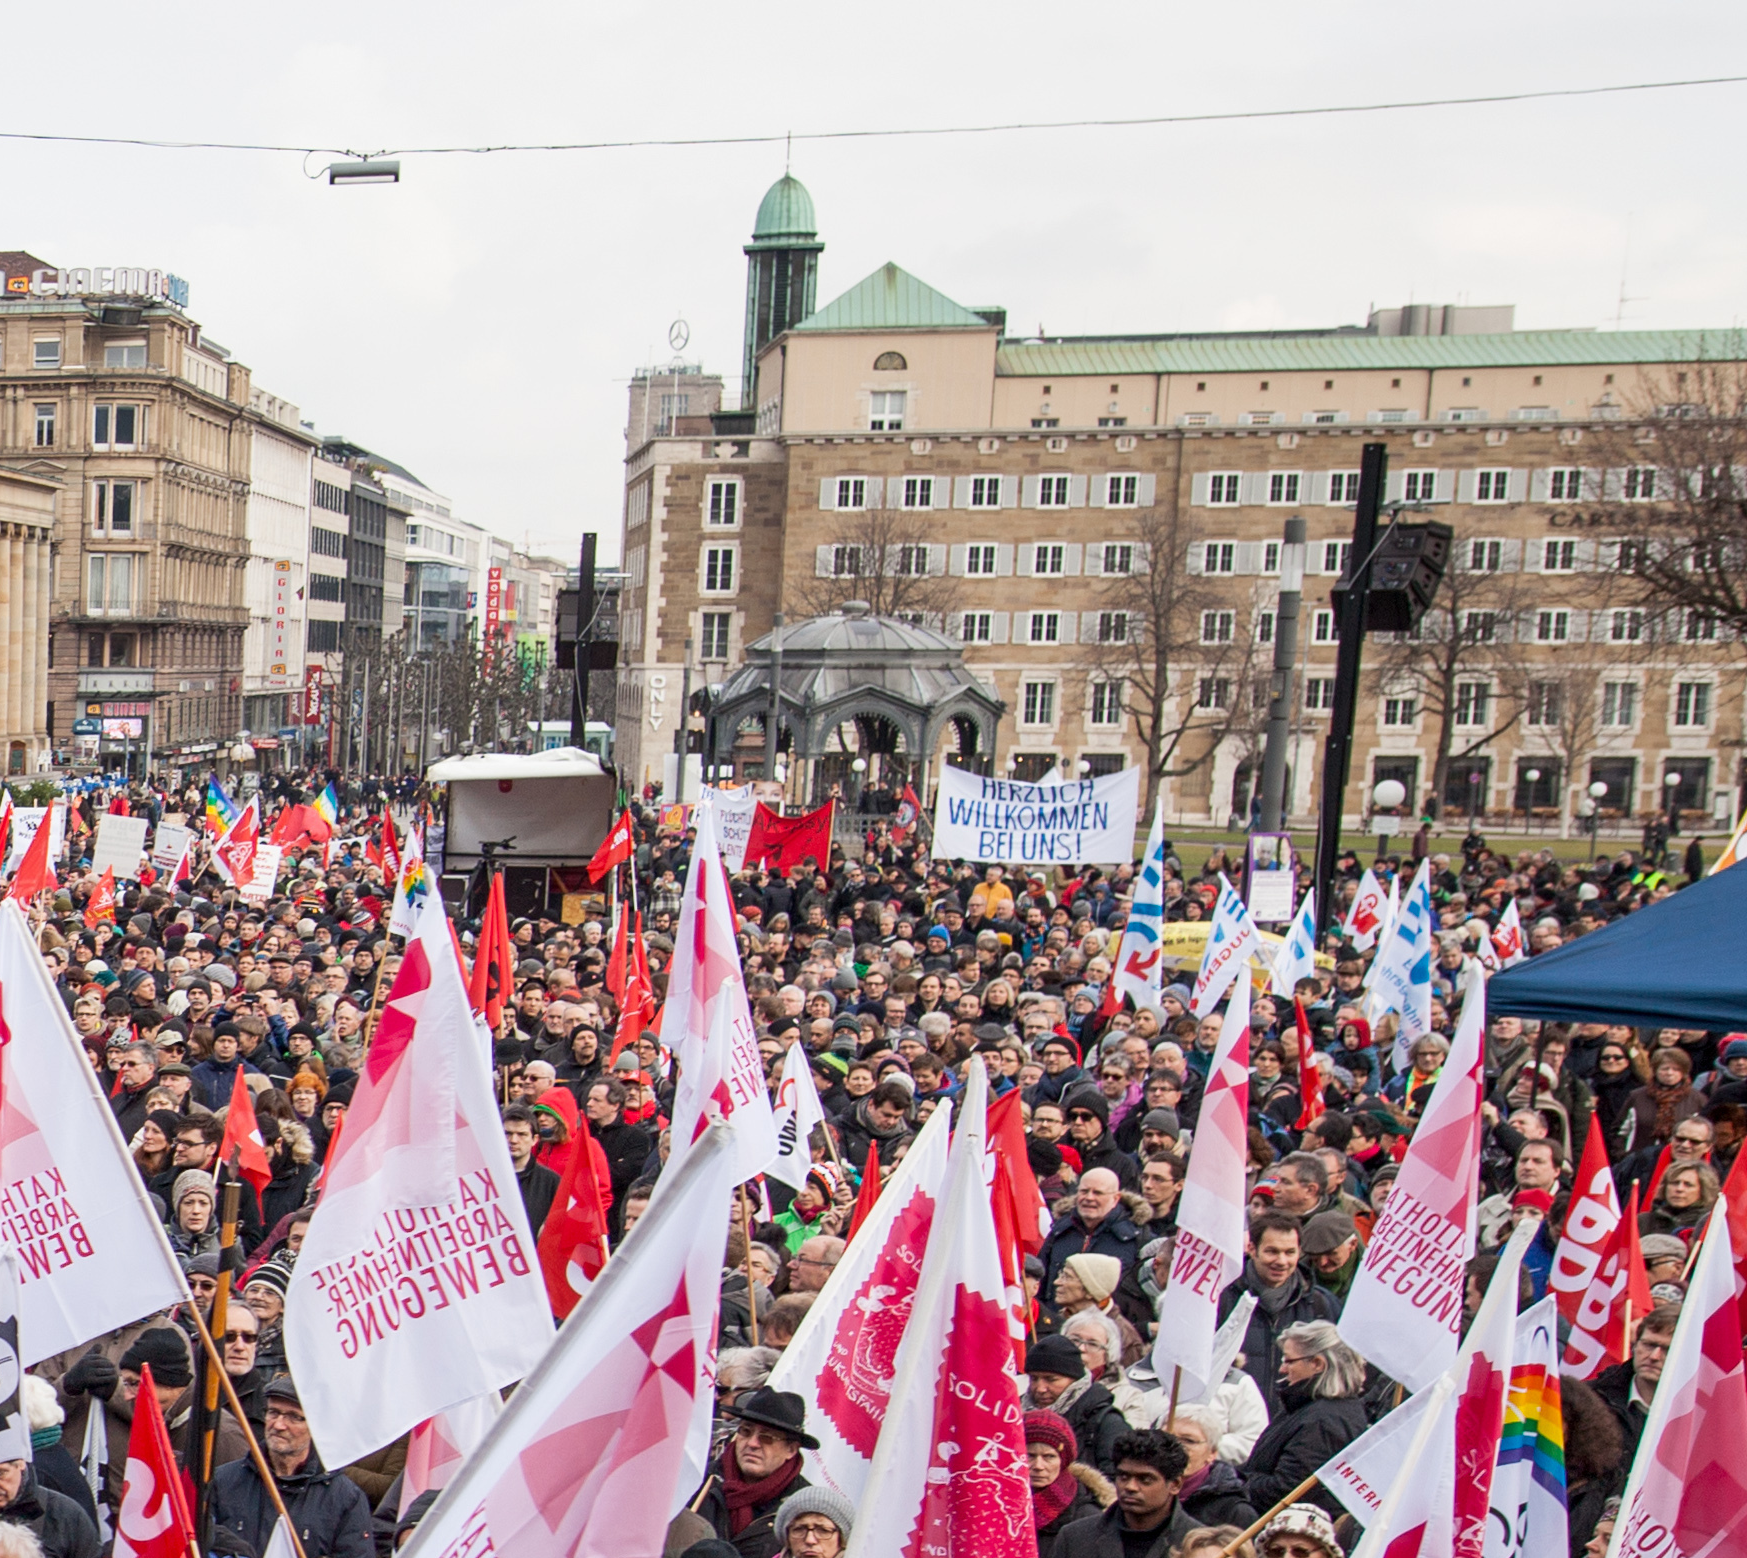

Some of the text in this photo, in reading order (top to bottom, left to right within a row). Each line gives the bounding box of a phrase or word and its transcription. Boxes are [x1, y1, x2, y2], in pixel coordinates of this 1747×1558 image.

[32, 267, 163, 297] CINEMA
[648, 674, 665, 731] ONLY
[980, 777, 1095, 803] HERZLICH
[949, 799, 1109, 832] WILLKOMMEN
[1016, 833, 1083, 861] UNS!
